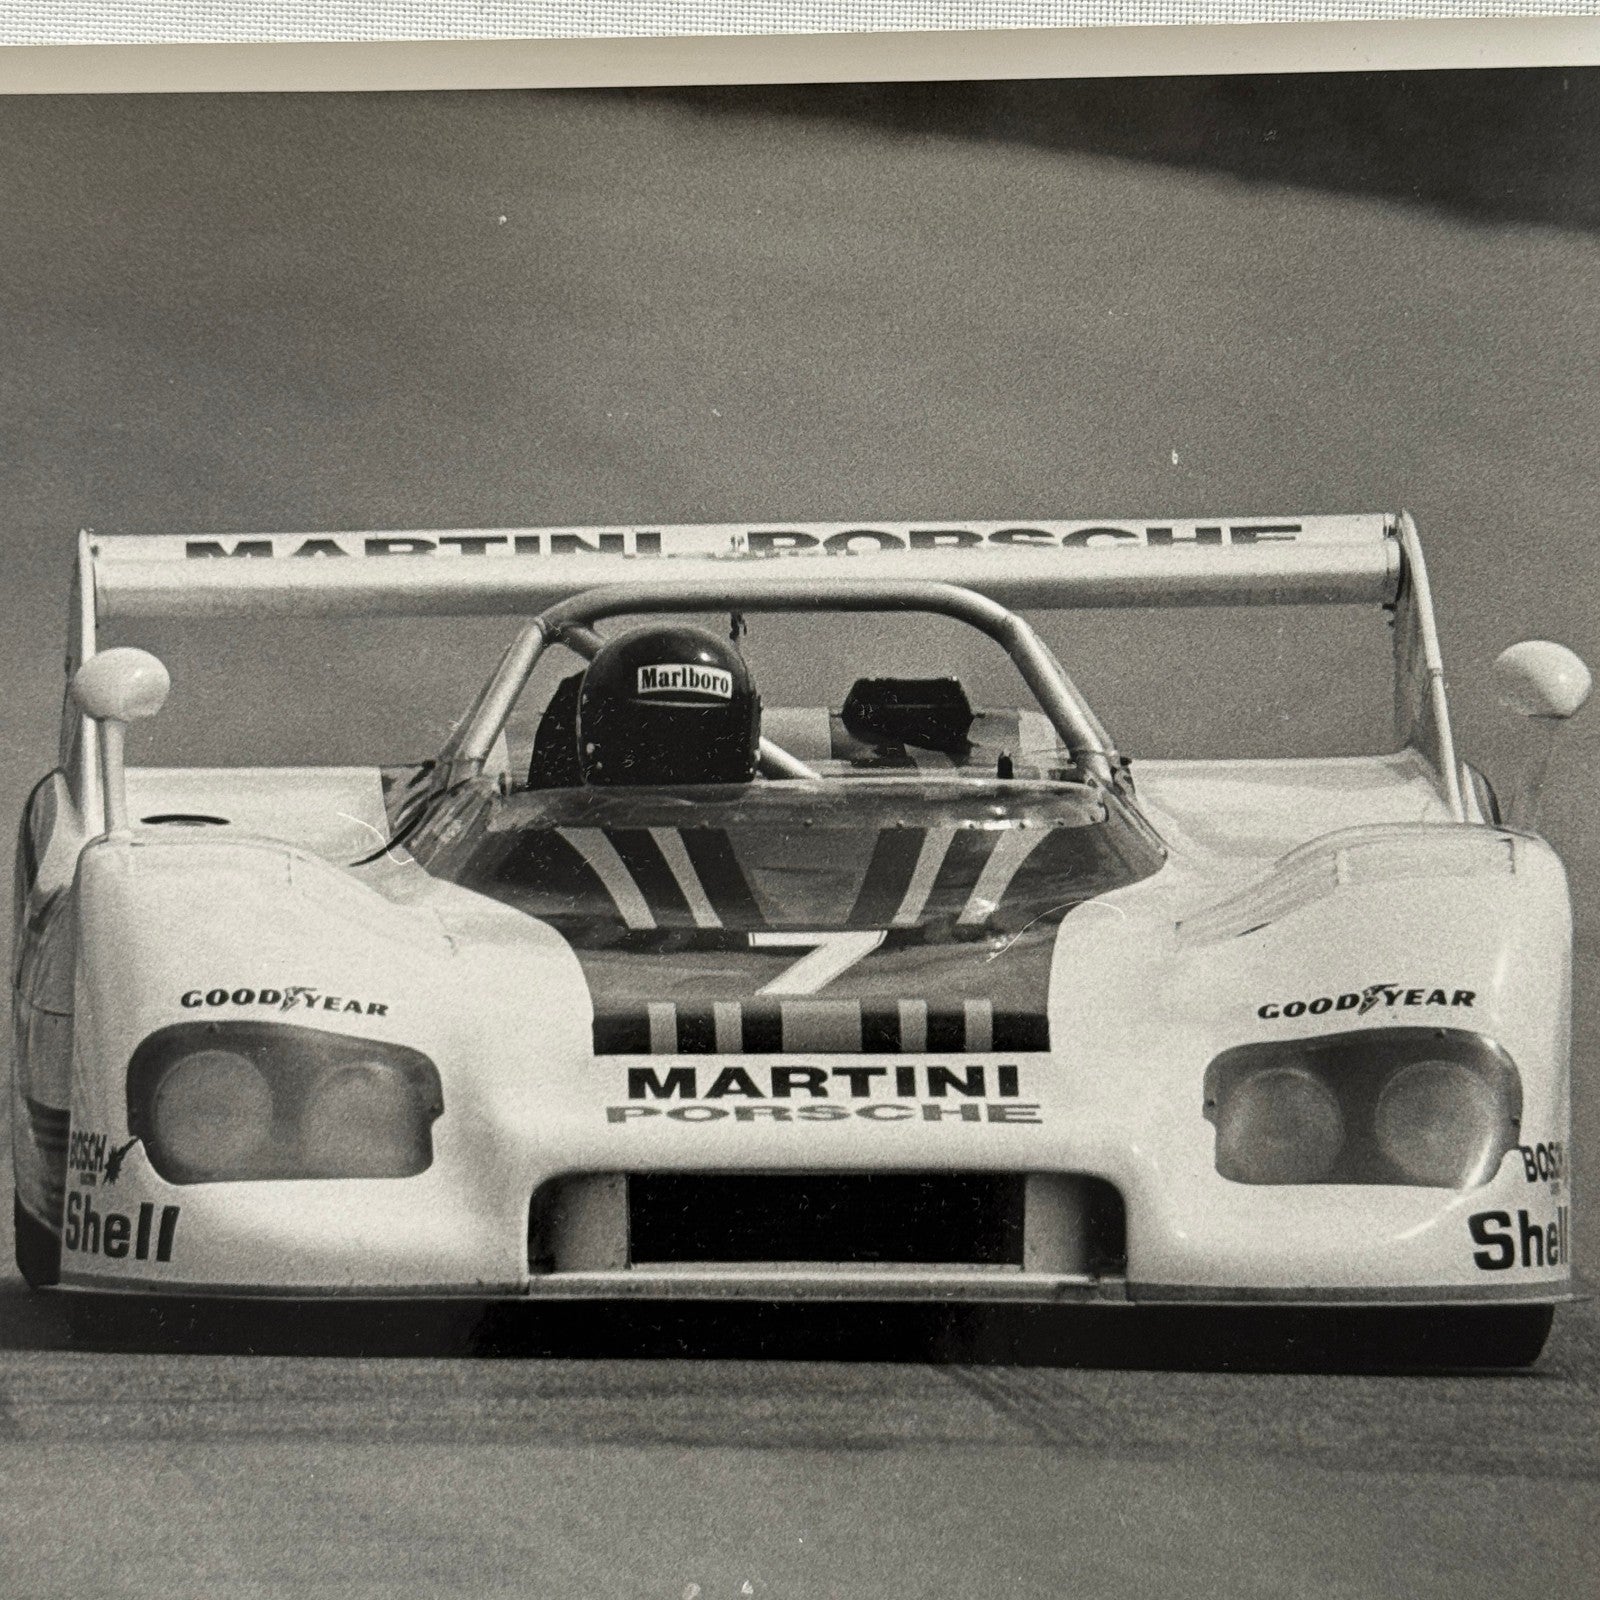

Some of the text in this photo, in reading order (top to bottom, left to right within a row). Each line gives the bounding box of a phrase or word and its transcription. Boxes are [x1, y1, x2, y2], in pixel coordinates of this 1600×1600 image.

[186, 525, 1302, 558] MARTINI PORSCHE
[640, 667, 730, 695] Marlboro
[748, 930, 888, 996] 7
[180, 986, 389, 1016] GOODYEAR
[1257, 983, 1477, 1019] GOODYEAR
[627, 1065, 1019, 1099] MARTINI
[606, 1104, 1043, 1124] PORSCHE
[65, 1191, 181, 1263] Shell
[1467, 1206, 1568, 1271] Shell
